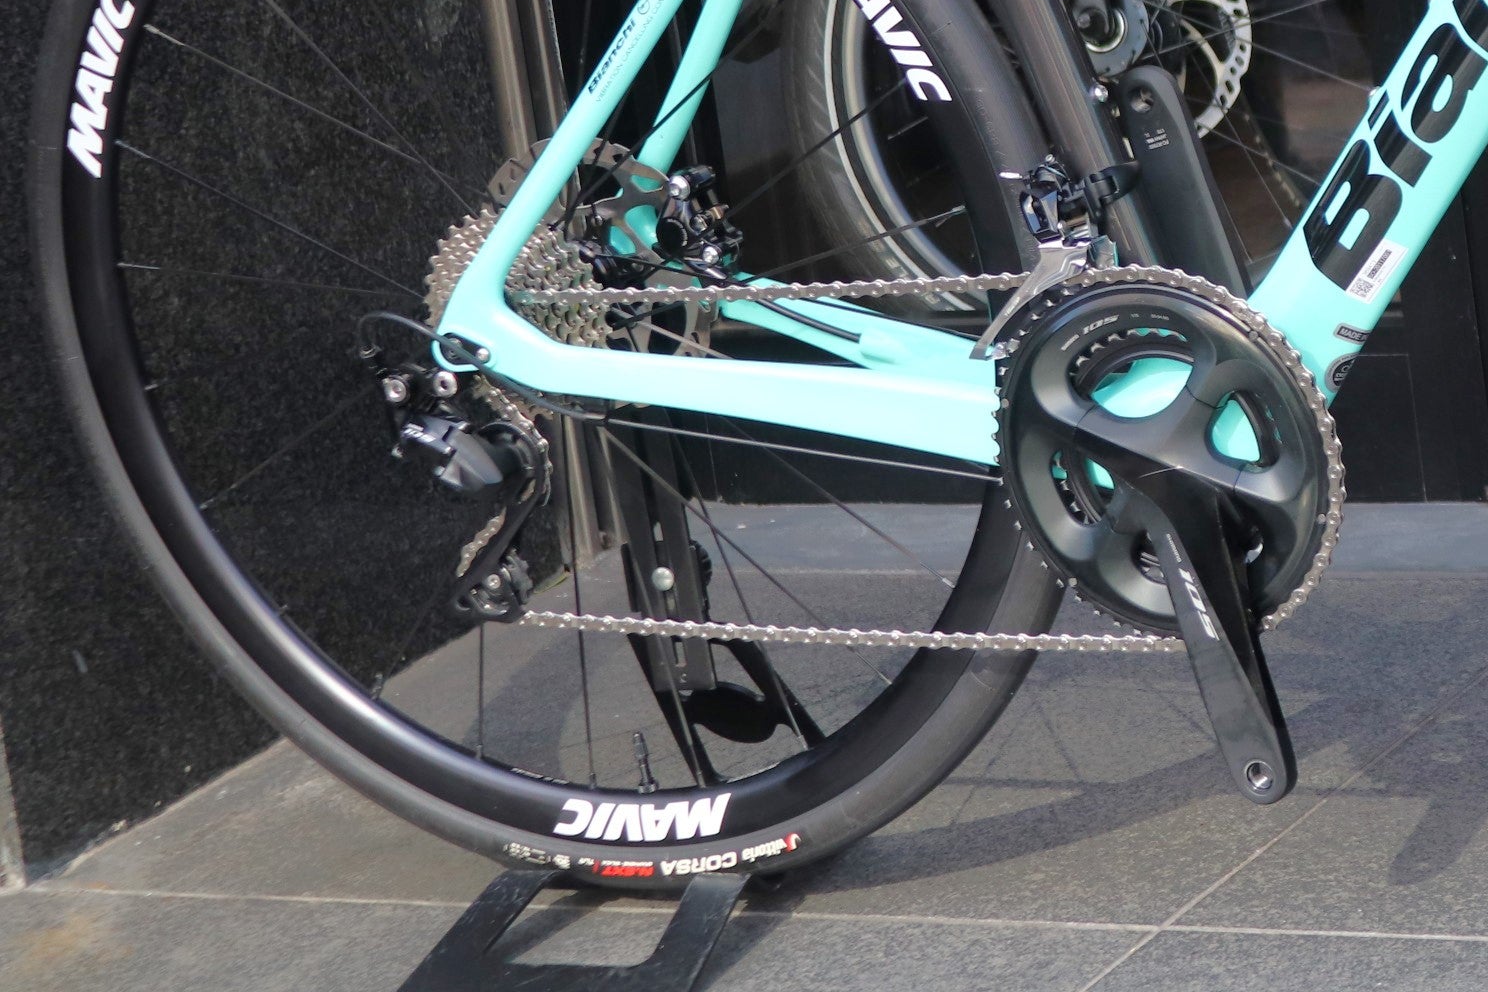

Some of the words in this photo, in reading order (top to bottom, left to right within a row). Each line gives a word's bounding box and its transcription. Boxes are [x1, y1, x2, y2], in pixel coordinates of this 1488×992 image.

[588, 19, 636, 95] Bianchi
[1179, 568, 1220, 641] 105
[553, 793, 732, 842] MAVIC
[660, 851, 738, 877] CORSA
